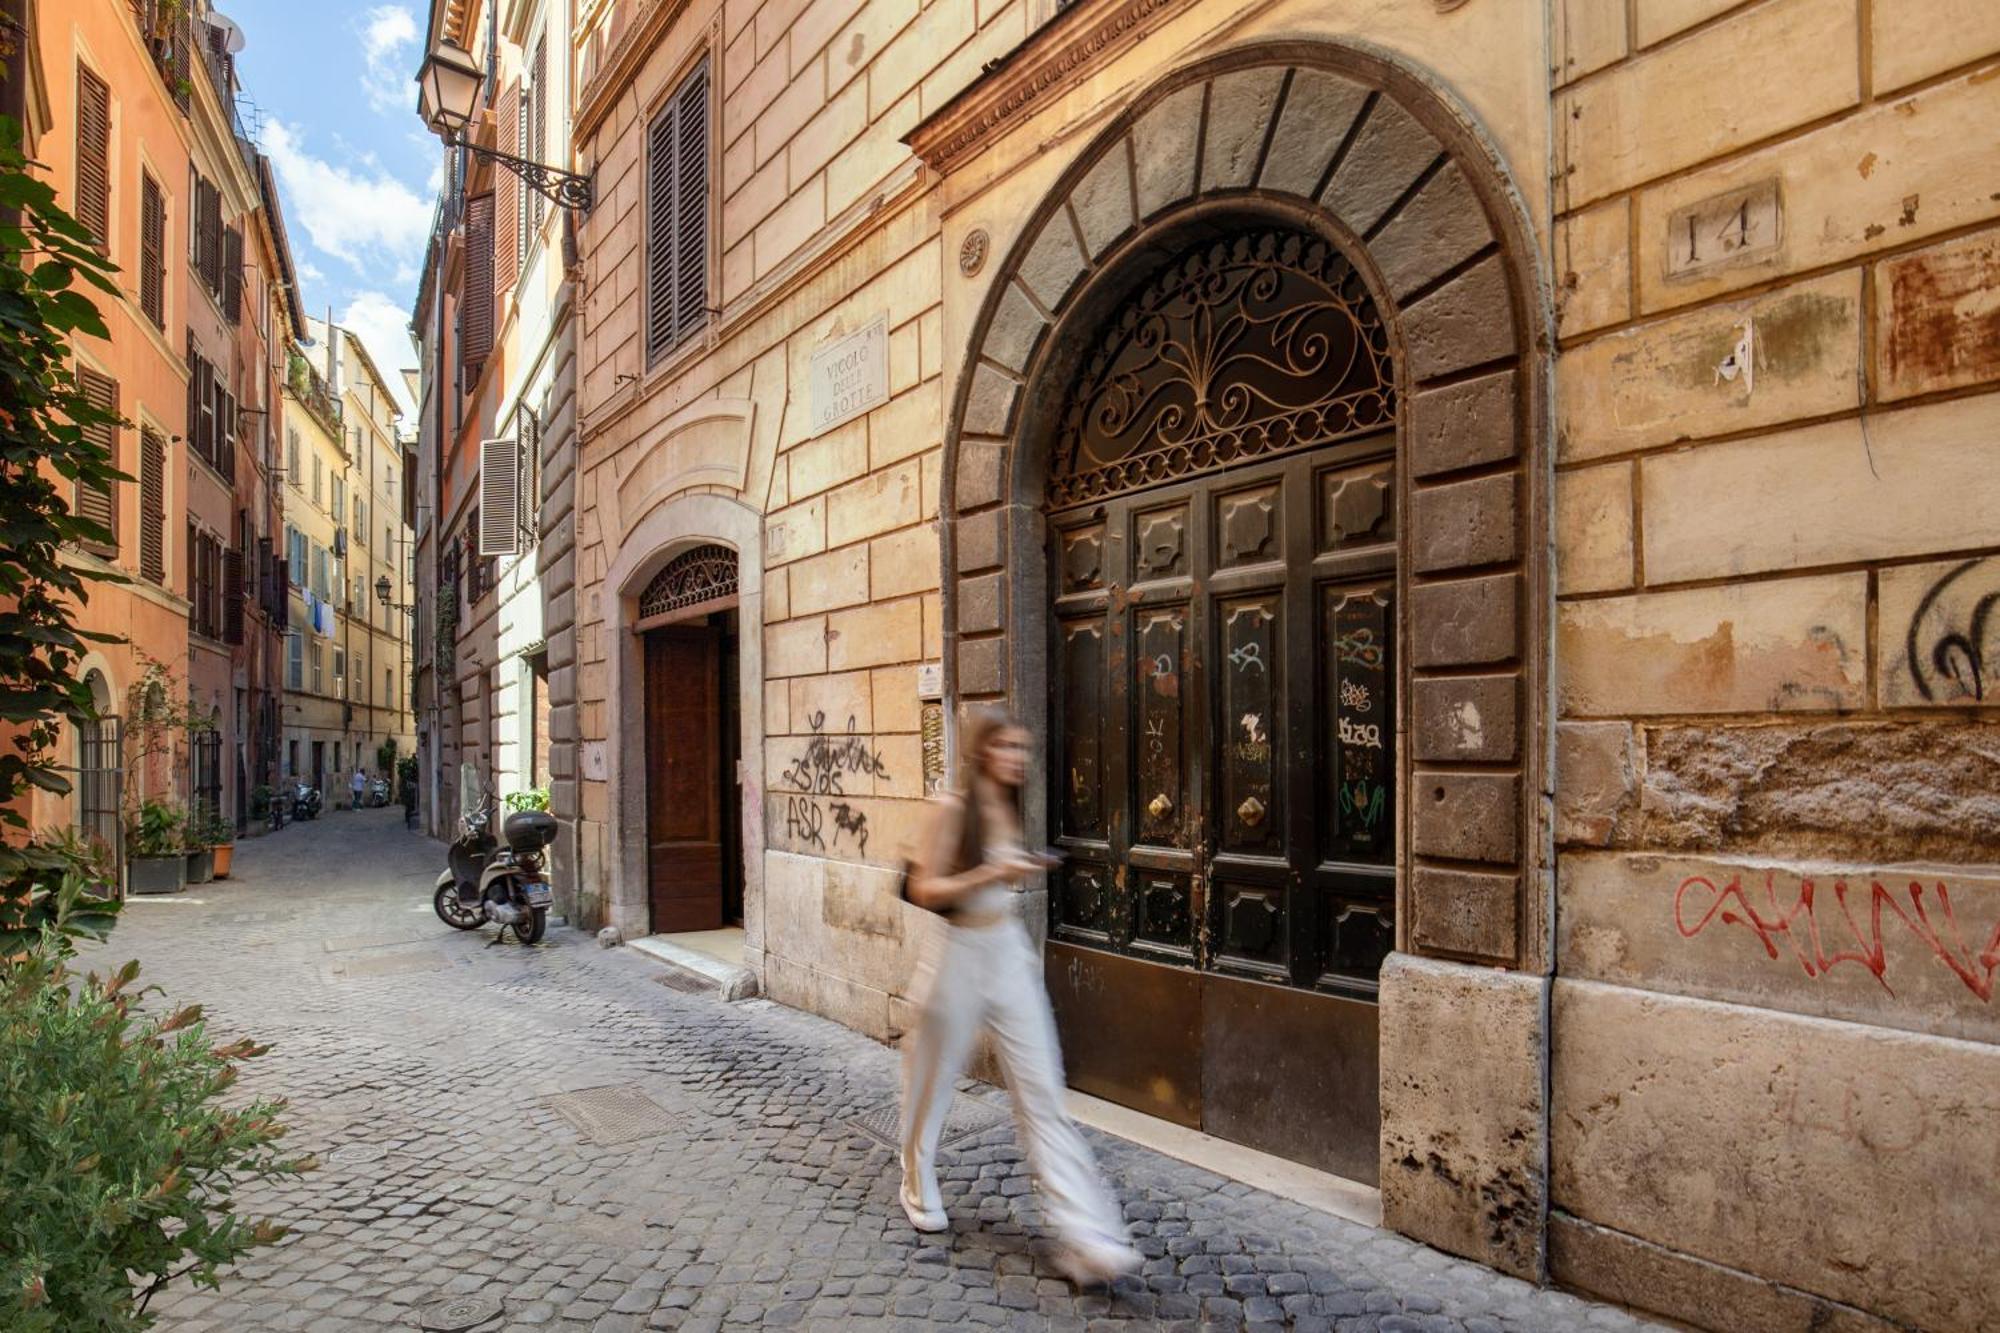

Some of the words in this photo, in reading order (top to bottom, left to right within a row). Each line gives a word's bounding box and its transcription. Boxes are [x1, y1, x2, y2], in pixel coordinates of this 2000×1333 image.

[1686, 198, 1760, 265] 14
[826, 346, 868, 379] VICOLO
[823, 384, 873, 421] GROTTE
